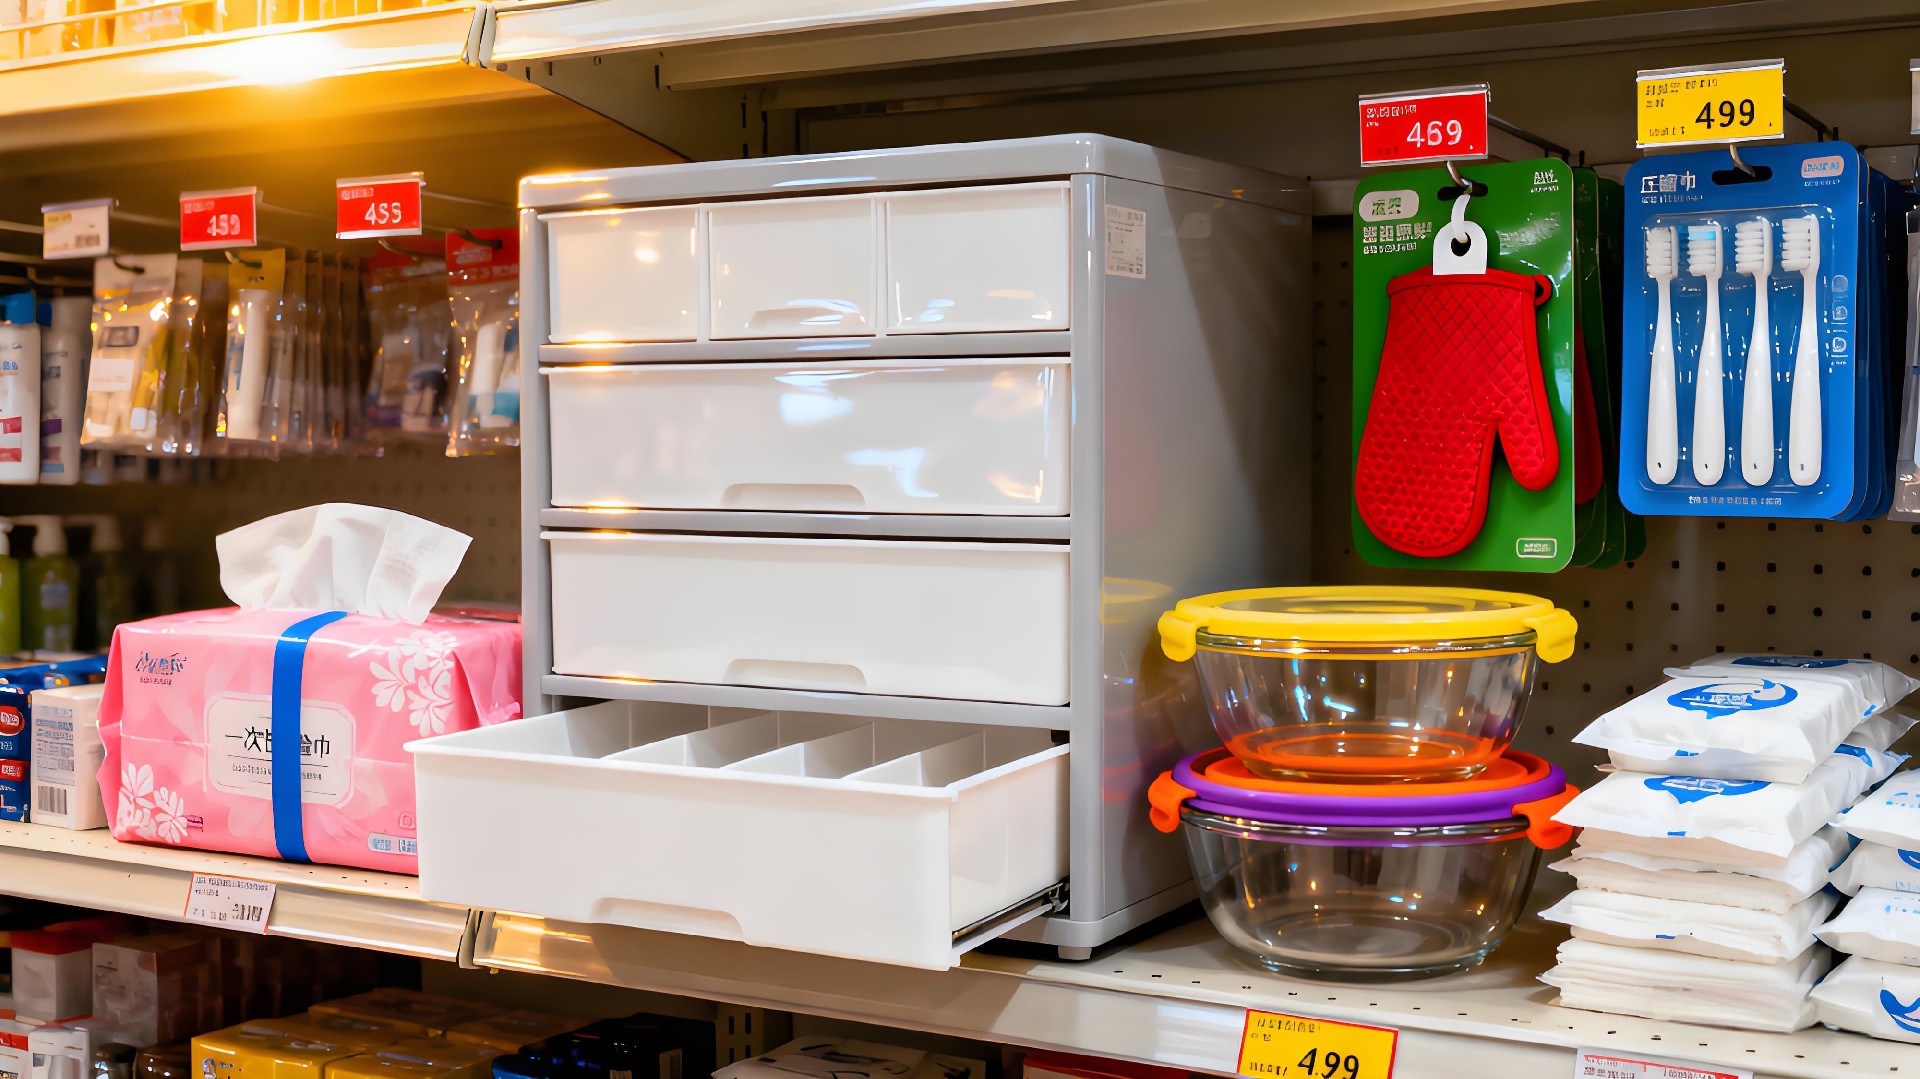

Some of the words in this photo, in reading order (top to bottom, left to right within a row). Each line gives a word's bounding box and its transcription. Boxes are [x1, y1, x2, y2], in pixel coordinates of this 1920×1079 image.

[1695, 98, 1755, 129] 499
[1406, 119, 1463, 148] 469
[1297, 1047, 1360, 1079] 4.99
